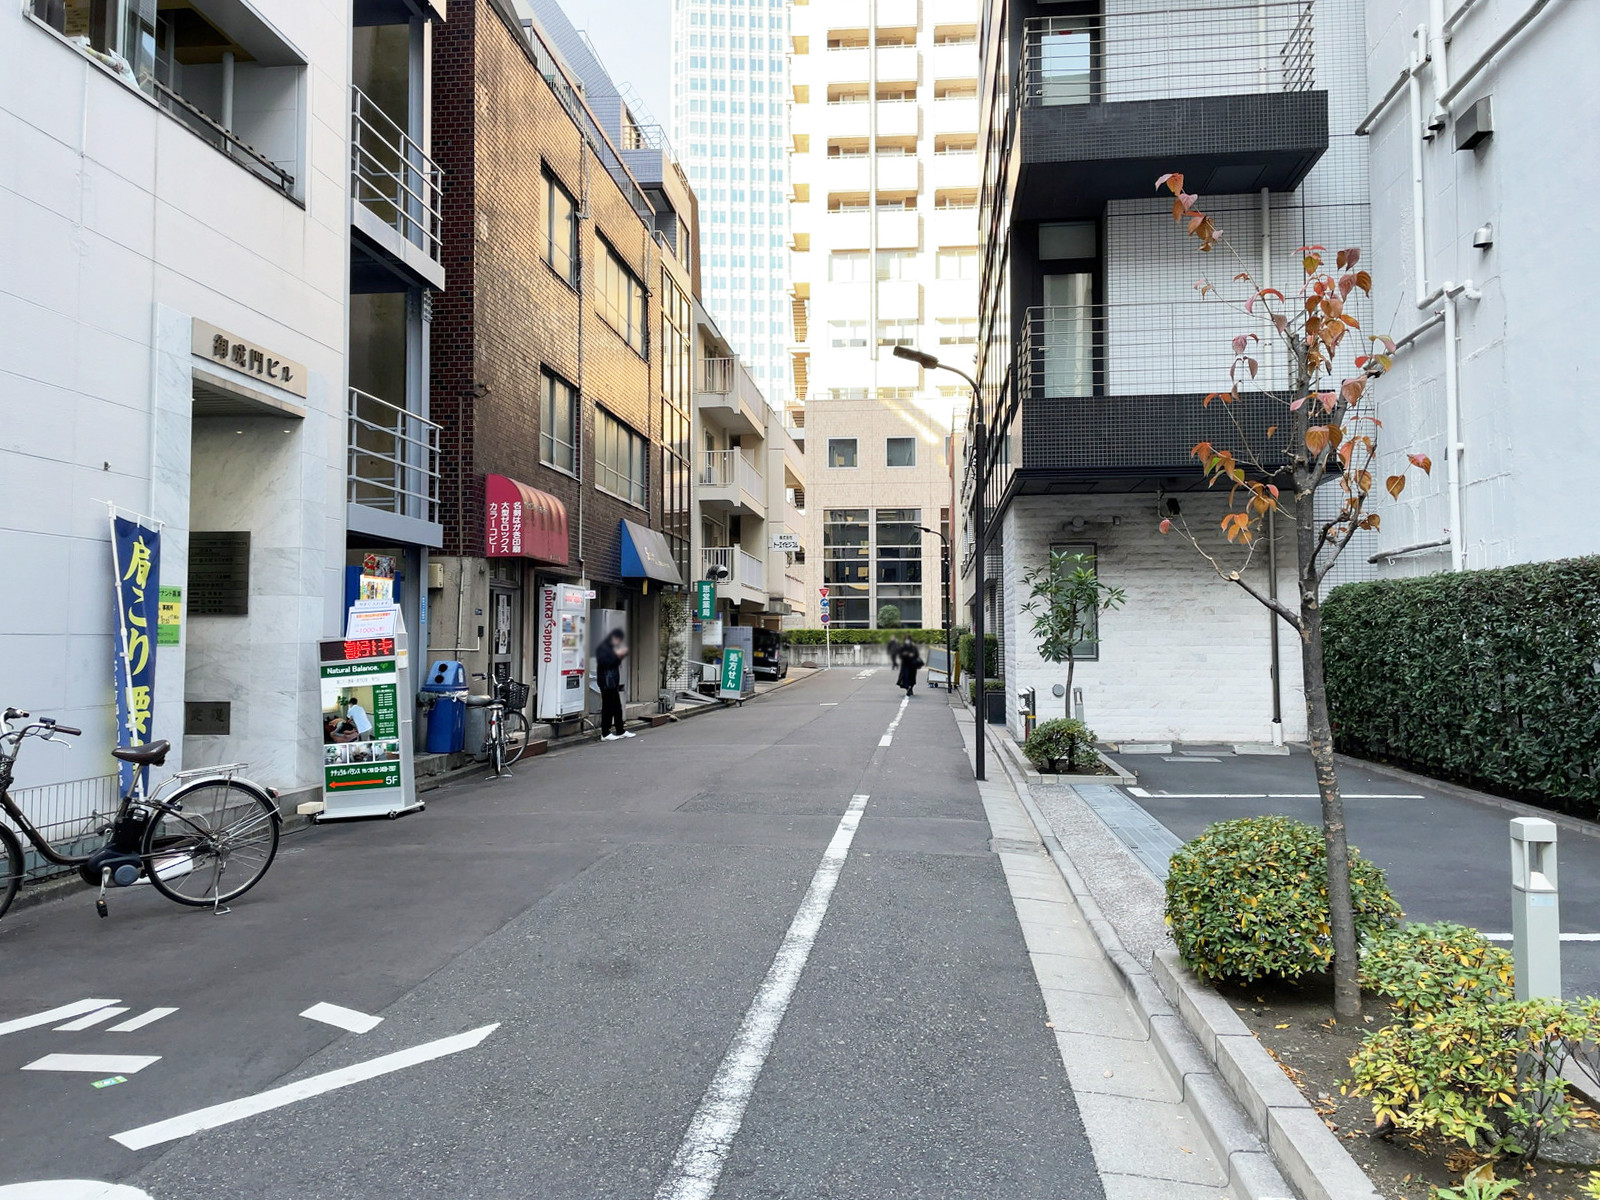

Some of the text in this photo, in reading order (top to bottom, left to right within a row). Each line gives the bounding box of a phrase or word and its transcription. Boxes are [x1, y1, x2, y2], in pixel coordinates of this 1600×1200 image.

[212, 333, 293, 382] 御成門ビル
[488, 502, 498, 553] カラーコピー
[500, 501, 510, 553] 大型ゼロックス
[512, 501, 522, 553] 名刺はがき印刷
[326, 666, 351, 675] Natural
[727, 652, 738, 688] 処方せん
[385, 775, 398, 785] 5F
